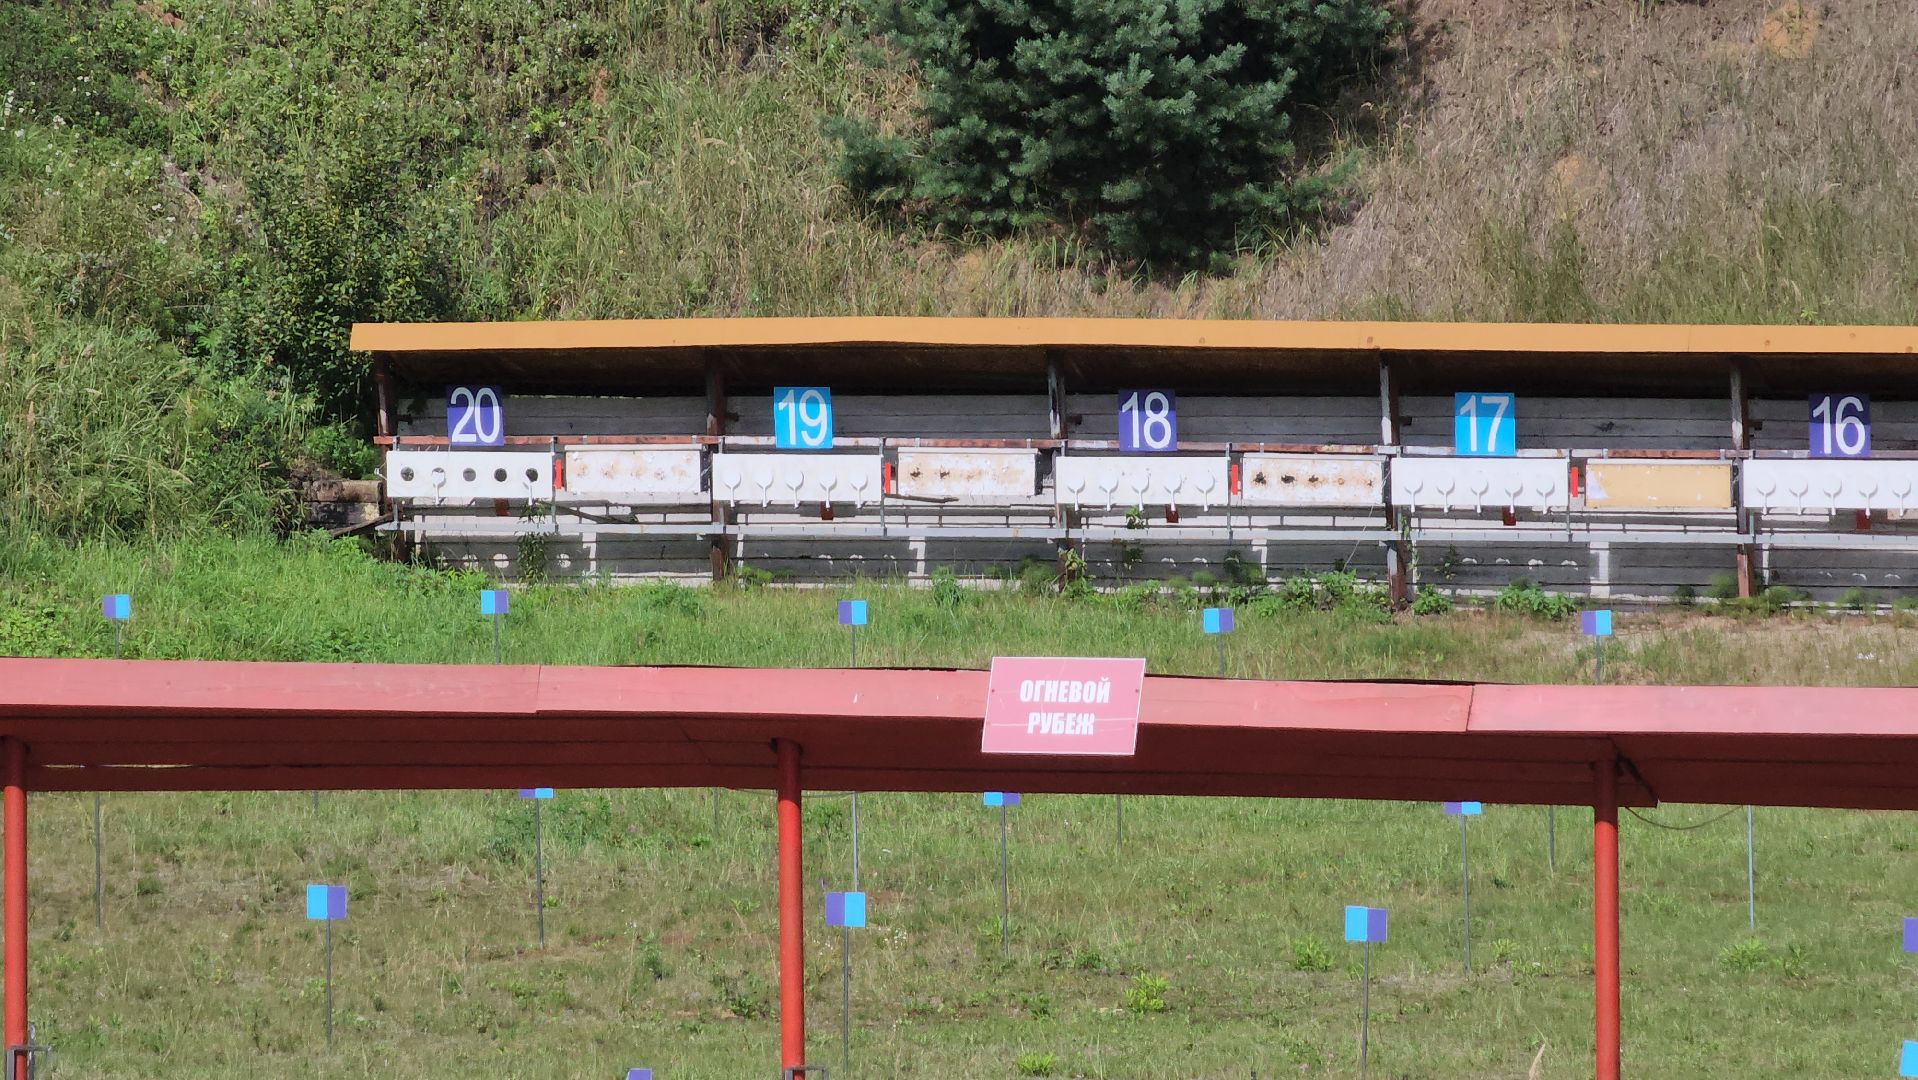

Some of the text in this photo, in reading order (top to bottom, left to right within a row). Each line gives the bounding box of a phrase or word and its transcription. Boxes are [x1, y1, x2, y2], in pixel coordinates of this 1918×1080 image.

[450, 386, 501, 444] 20
[778, 388, 829, 446] 19
[1121, 391, 1172, 450] 18
[1459, 395, 1509, 452] 17
[1811, 395, 1867, 455] 16
[1019, 676, 1111, 704] ОГНЕВОЙ
[1027, 712, 1096, 735] РУБЕЖ
